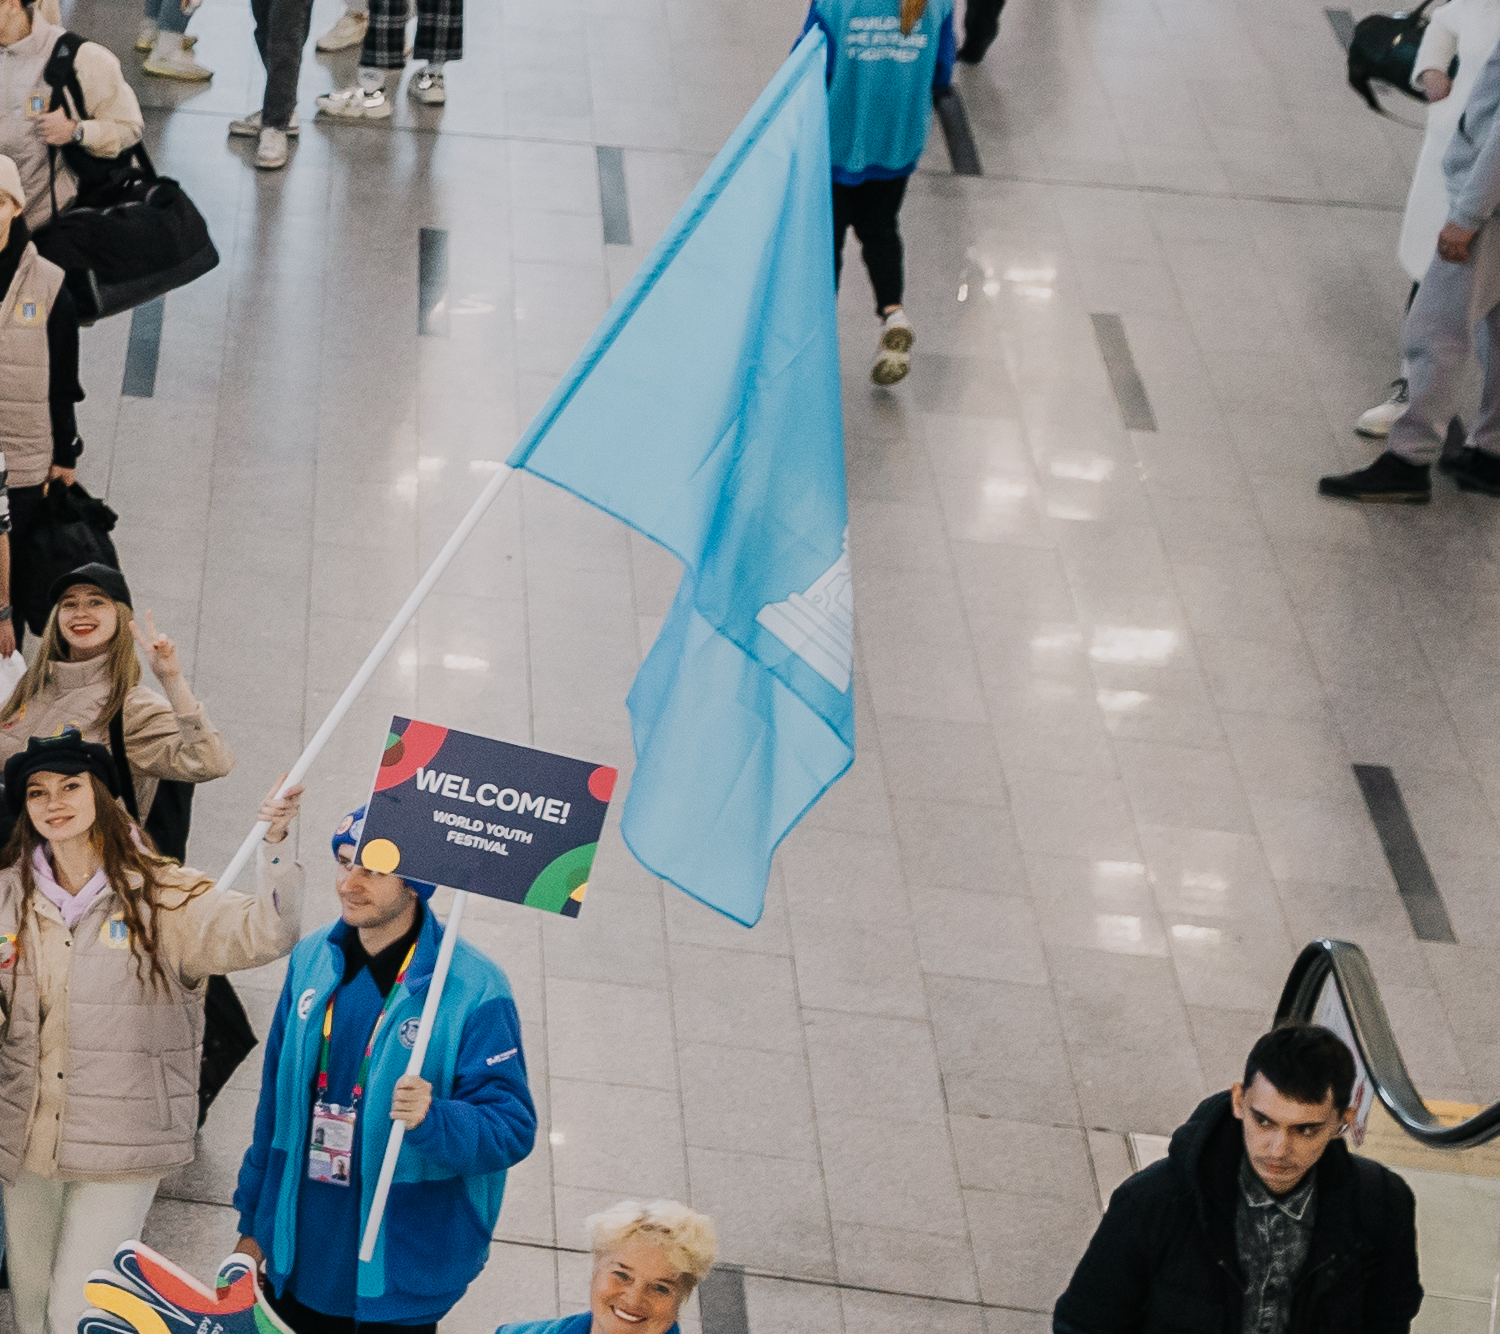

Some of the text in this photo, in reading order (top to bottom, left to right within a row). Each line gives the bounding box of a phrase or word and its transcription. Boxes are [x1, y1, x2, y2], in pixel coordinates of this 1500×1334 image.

[416, 767, 572, 825] WELCOME!
[433, 809, 533, 845] WORLD YOUTH
[446, 830, 510, 857] FESTIVAL
